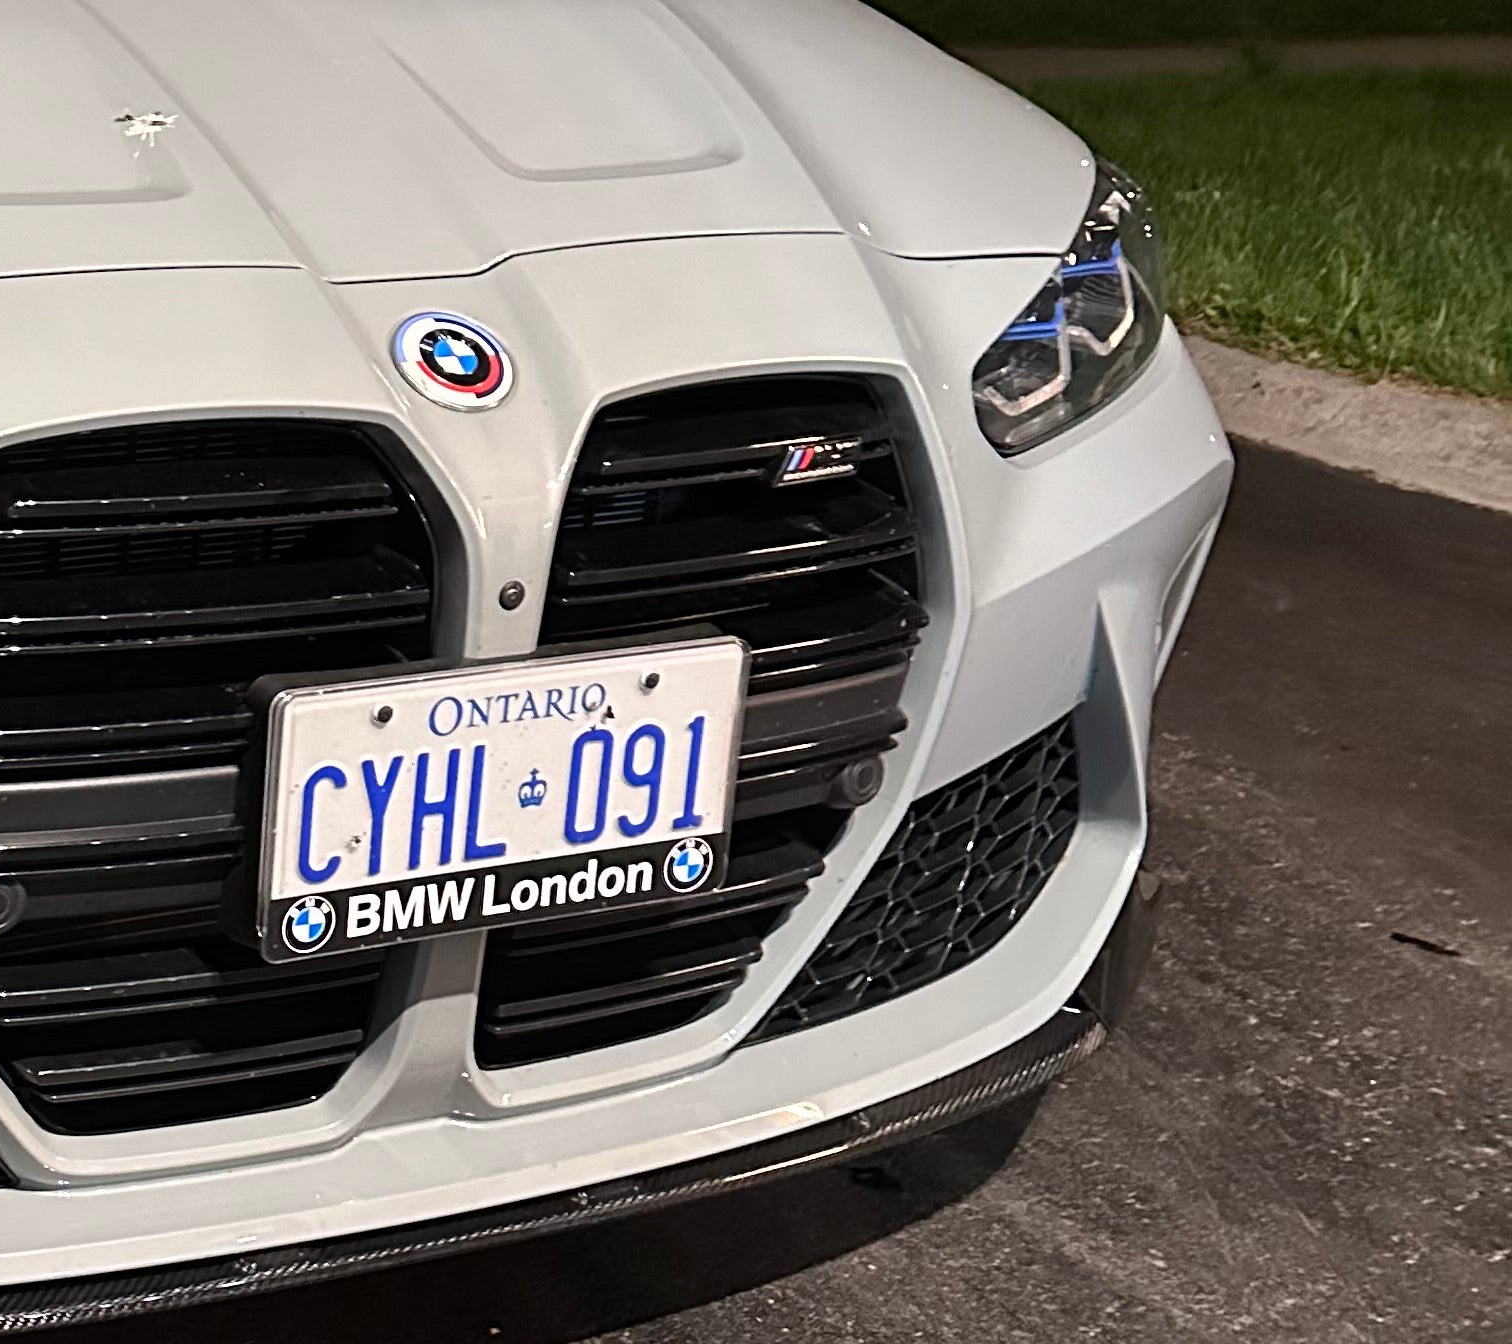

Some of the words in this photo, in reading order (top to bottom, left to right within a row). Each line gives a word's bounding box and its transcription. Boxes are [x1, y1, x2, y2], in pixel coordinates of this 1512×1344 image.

[297, 744, 507, 884] CYHL
[563, 716, 706, 845] 091
[346, 877, 476, 939] BMW
[481, 859, 654, 917] London
